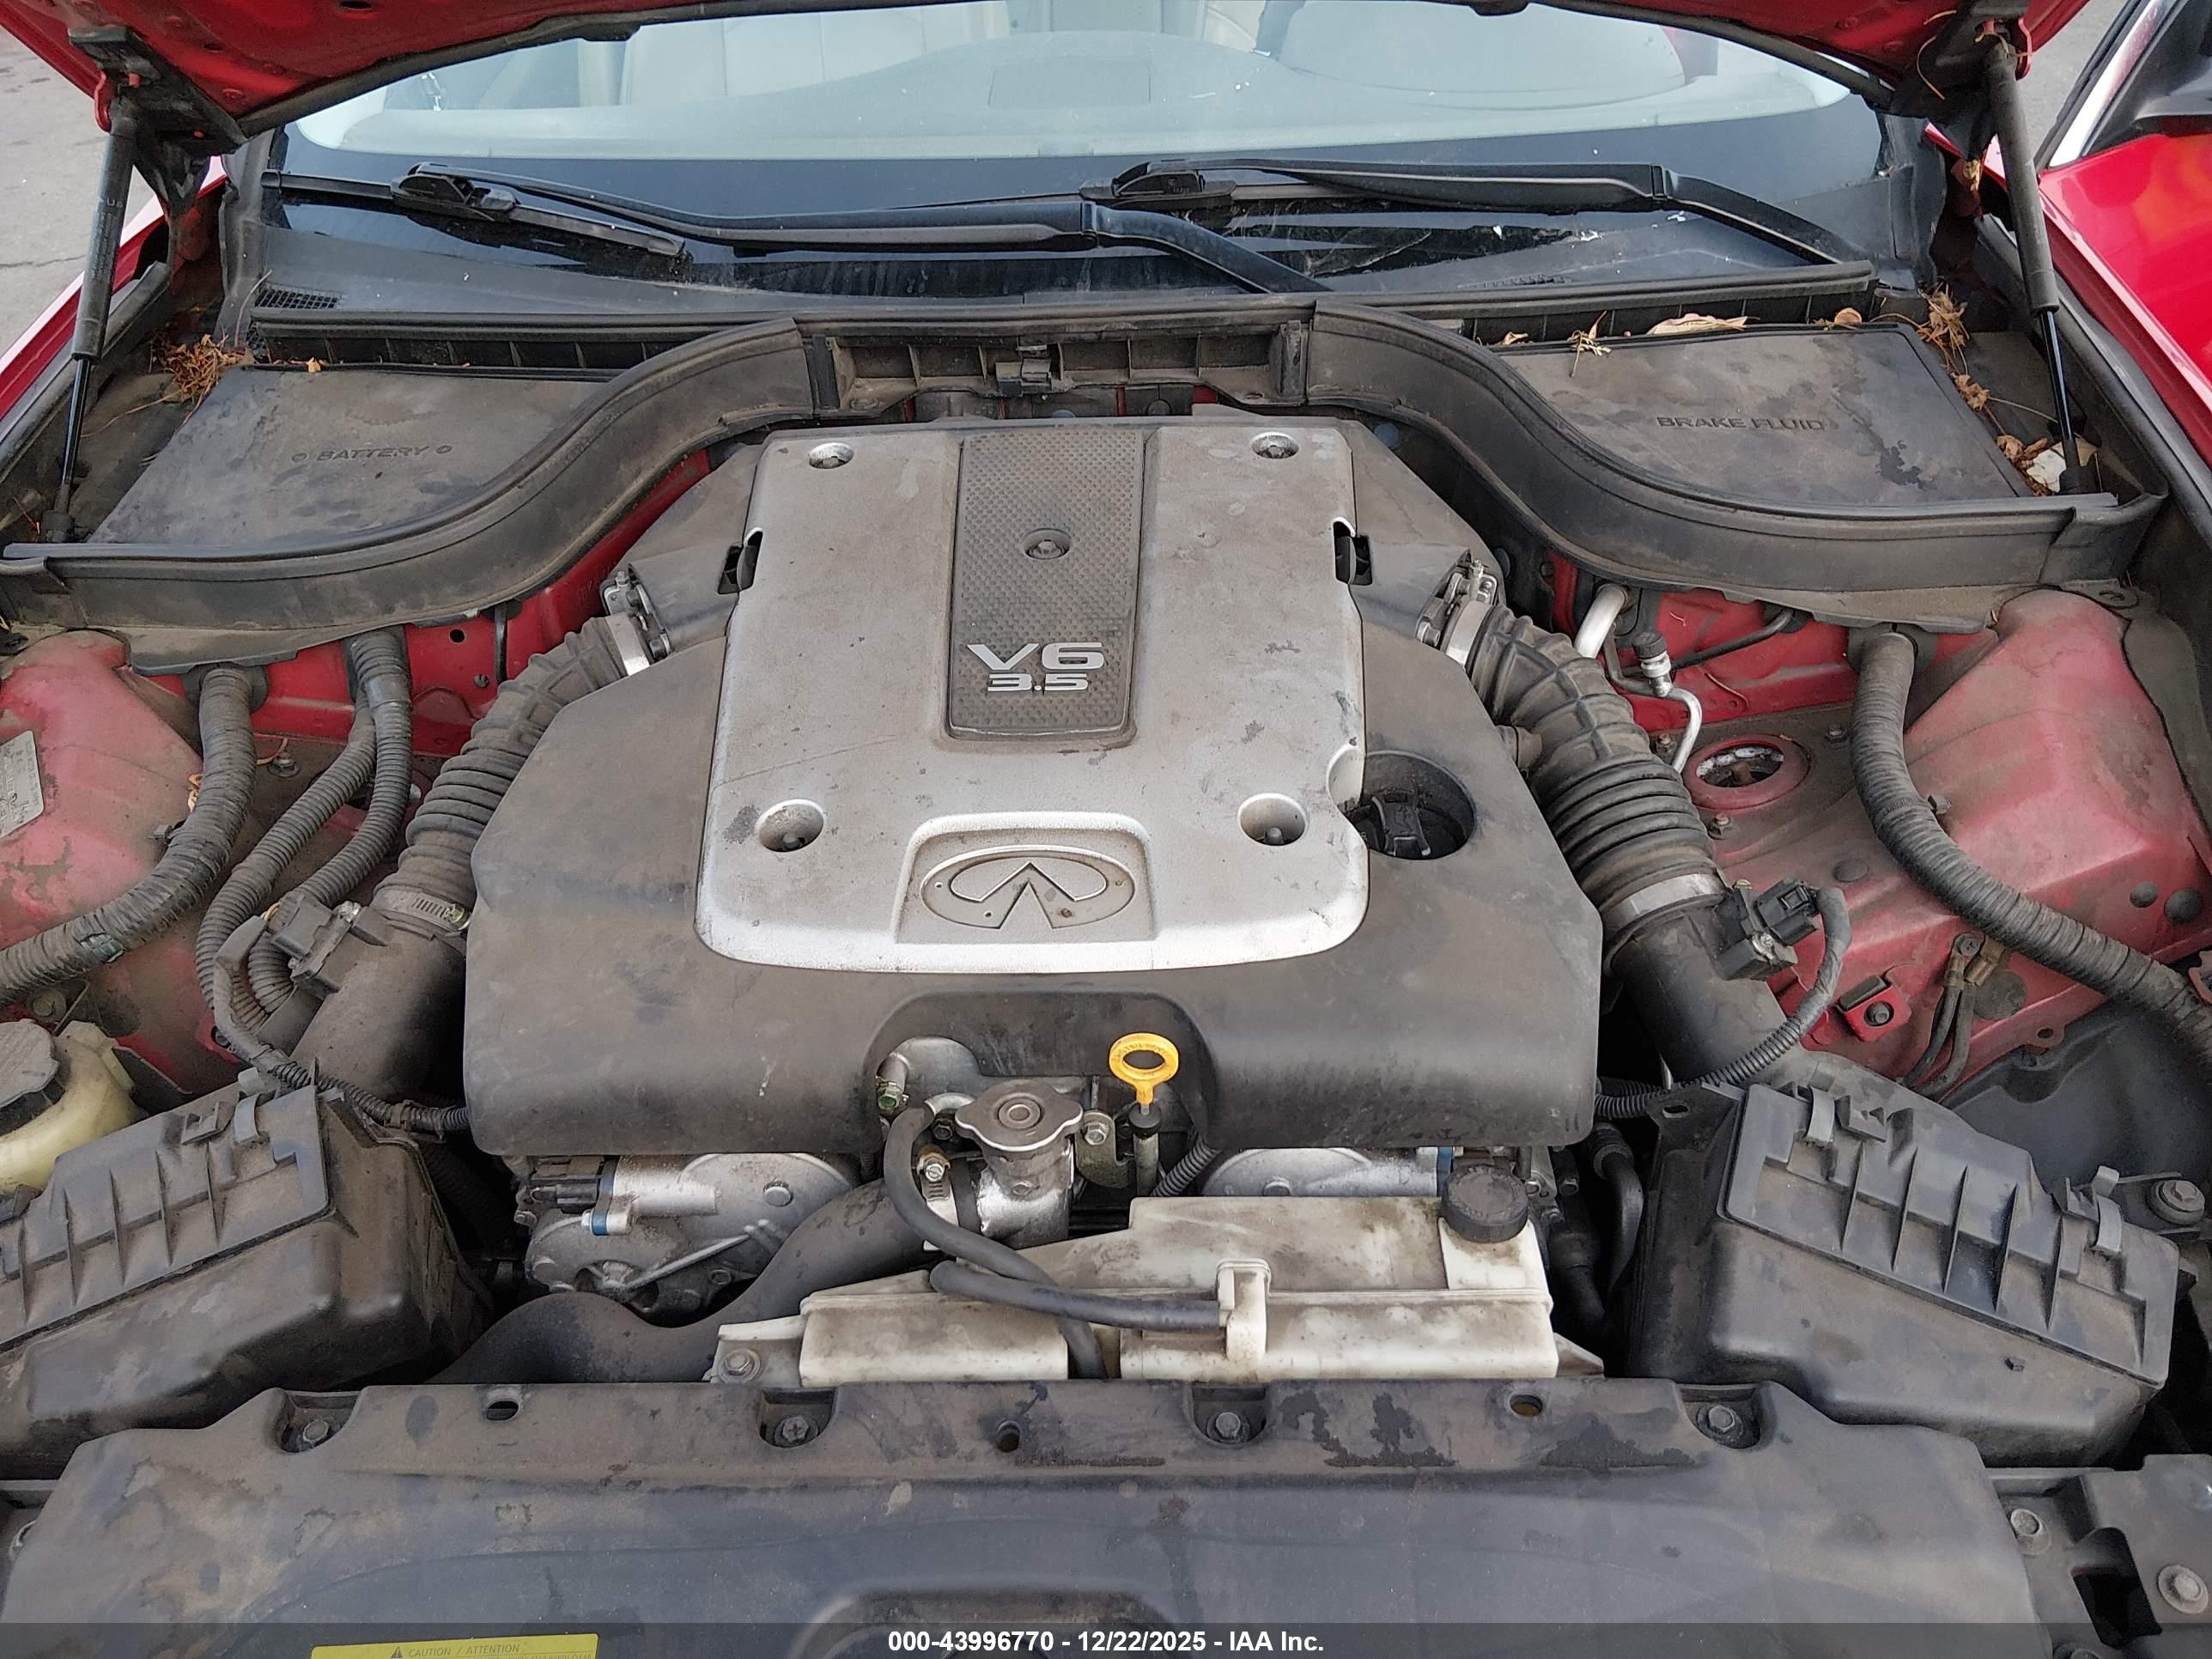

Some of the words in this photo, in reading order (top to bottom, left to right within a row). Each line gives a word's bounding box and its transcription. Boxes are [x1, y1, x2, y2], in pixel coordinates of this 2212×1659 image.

[1656, 416, 1747, 429] BRAKE
[1751, 418, 1826, 431] FLUID
[315, 445, 429, 462] BATTERY
[966, 641, 1105, 671] V6
[987, 673, 1089, 692] 3.5
[408, 1646, 452, 1657] CAUTION
[465, 1644, 520, 1656] ATTENTION
